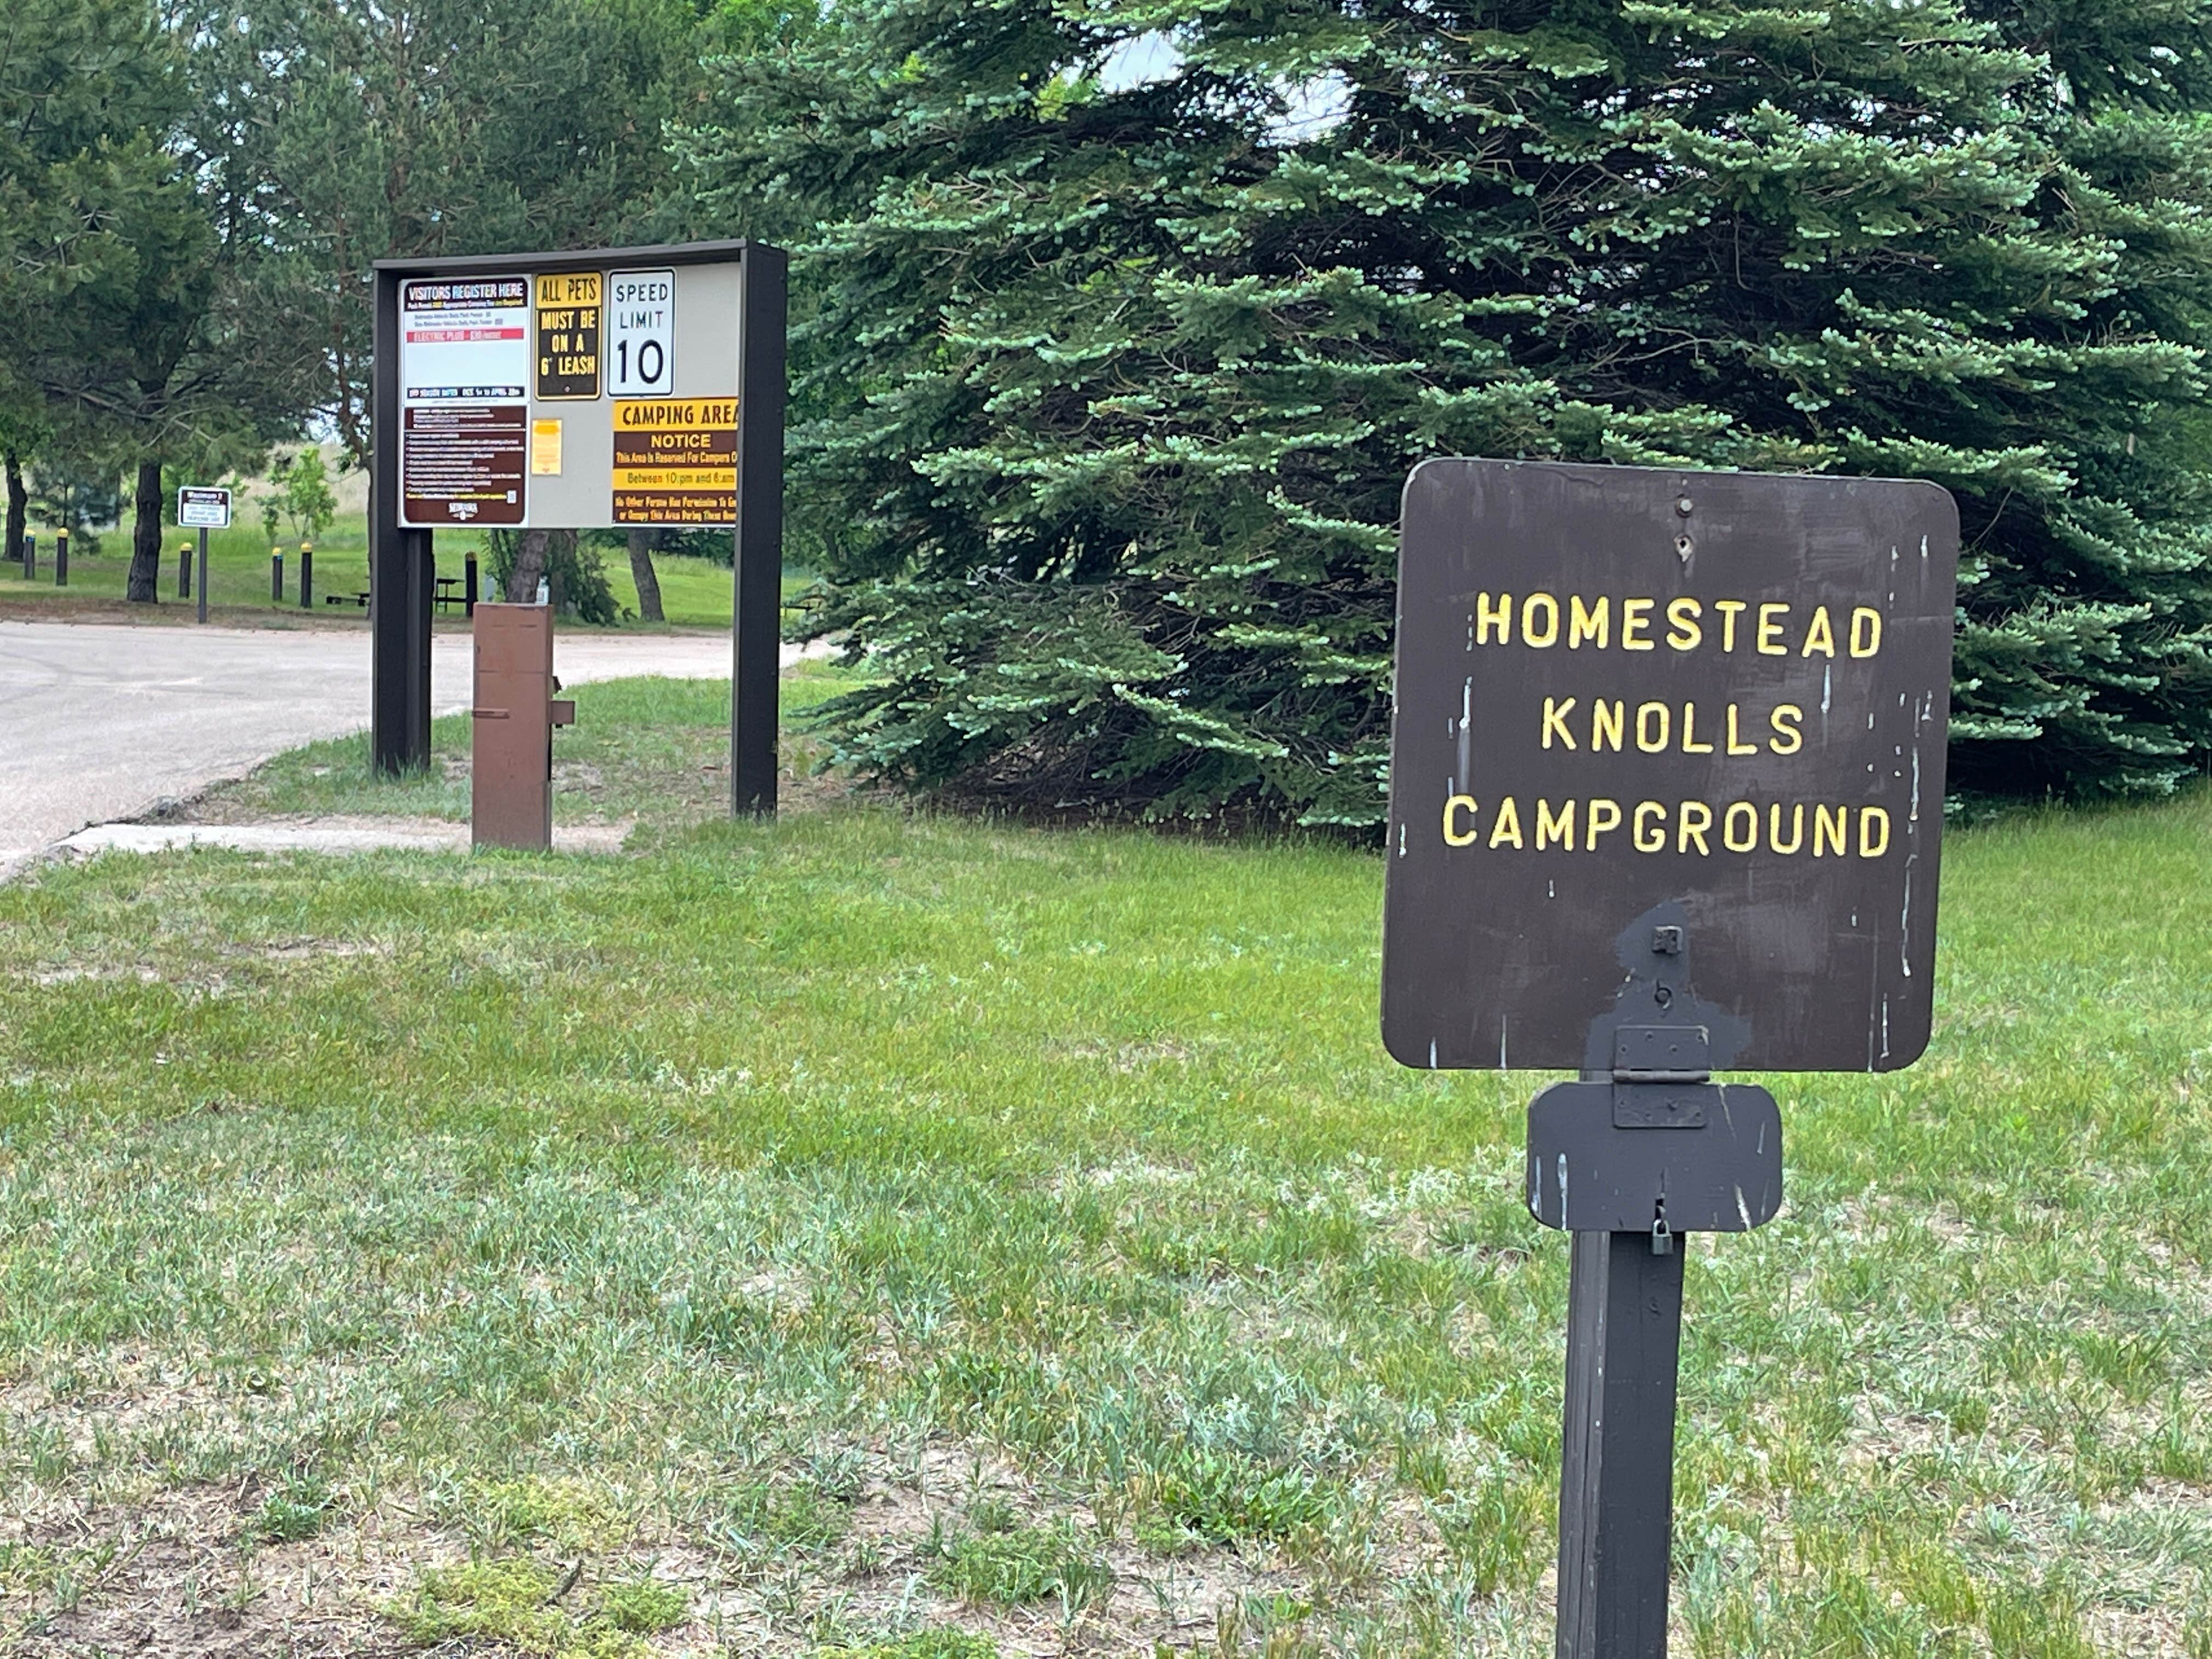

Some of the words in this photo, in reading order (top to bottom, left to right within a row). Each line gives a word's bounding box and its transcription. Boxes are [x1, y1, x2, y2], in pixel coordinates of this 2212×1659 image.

[408, 285, 451, 300] VISITORS
[452, 283, 497, 299] REGISTER
[499, 282, 523, 297] HERE
[541, 279, 561, 302] ALL
[568, 277, 597, 302] PETS
[616, 283, 668, 302] SPEED
[541, 311, 574, 330] MUST
[580, 309, 596, 329] BE
[620, 311, 664, 330] LIMIT
[551, 334, 568, 353] ON
[575, 333, 584, 352] A
[558, 356, 596, 376] LEASH
[617, 339, 664, 385] 10
[623, 405, 693, 426] CAMPING
[651, 434, 712, 449] NOTICE
[617, 451, 630, 464] This
[631, 452, 647, 464] Area
[655, 451, 686, 464] Reserved
[687, 451, 699, 463] For
[628, 472, 663, 484] Between
[696, 472, 712, 483] and
[1476, 591, 1882, 658] HOMESTEAD
[1541, 697, 1804, 756] KNOLLS
[1442, 794, 1891, 857] CAMPGROUND
